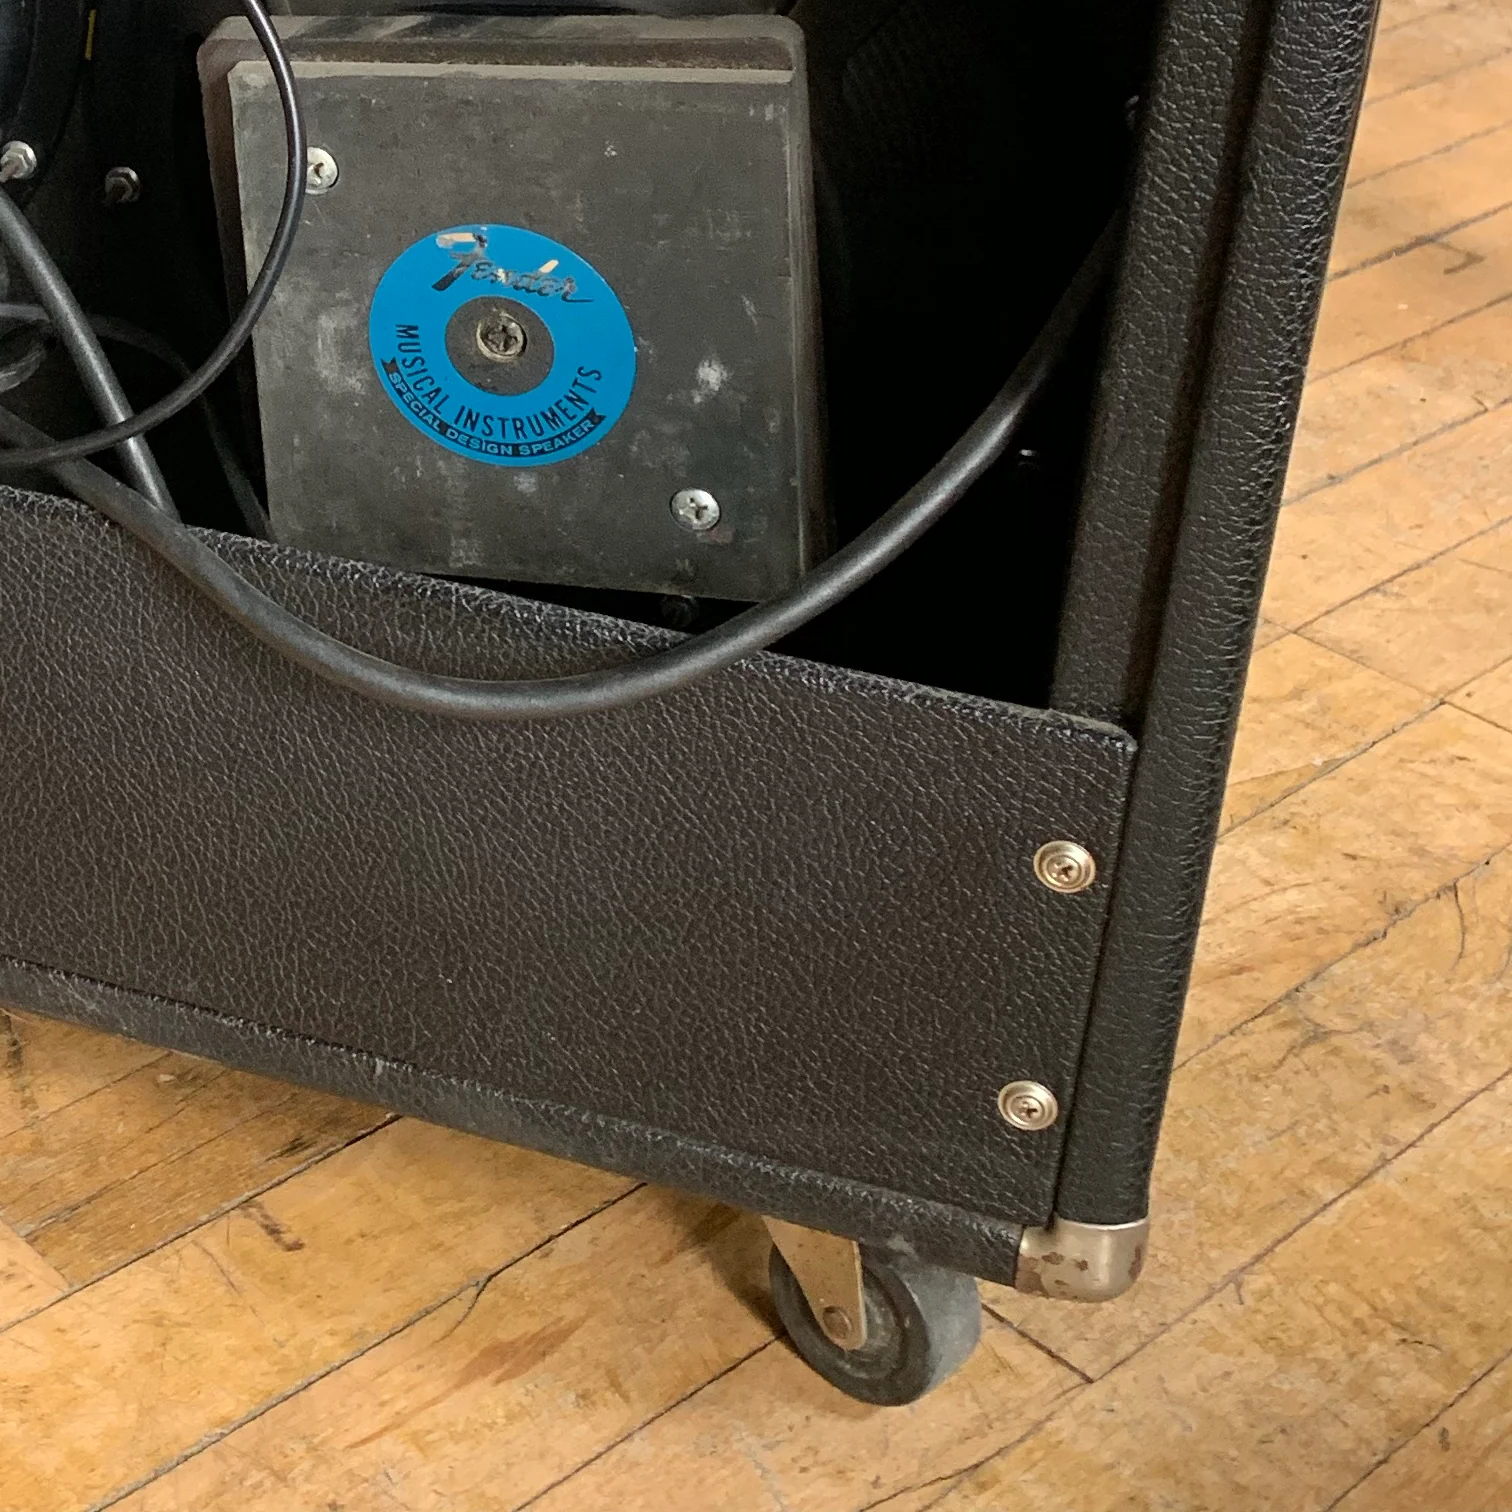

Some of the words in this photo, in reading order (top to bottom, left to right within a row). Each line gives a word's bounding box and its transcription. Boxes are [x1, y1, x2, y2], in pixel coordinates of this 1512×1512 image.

[431, 232, 595, 303] Fender
[388, 370, 443, 432] SPECIAL
[445, 428, 513, 456] DESIGN
[518, 418, 596, 456] SPEAKER
[395, 324, 450, 415] MUSICAL
[454, 365, 602, 440] INSTRUMENTS
